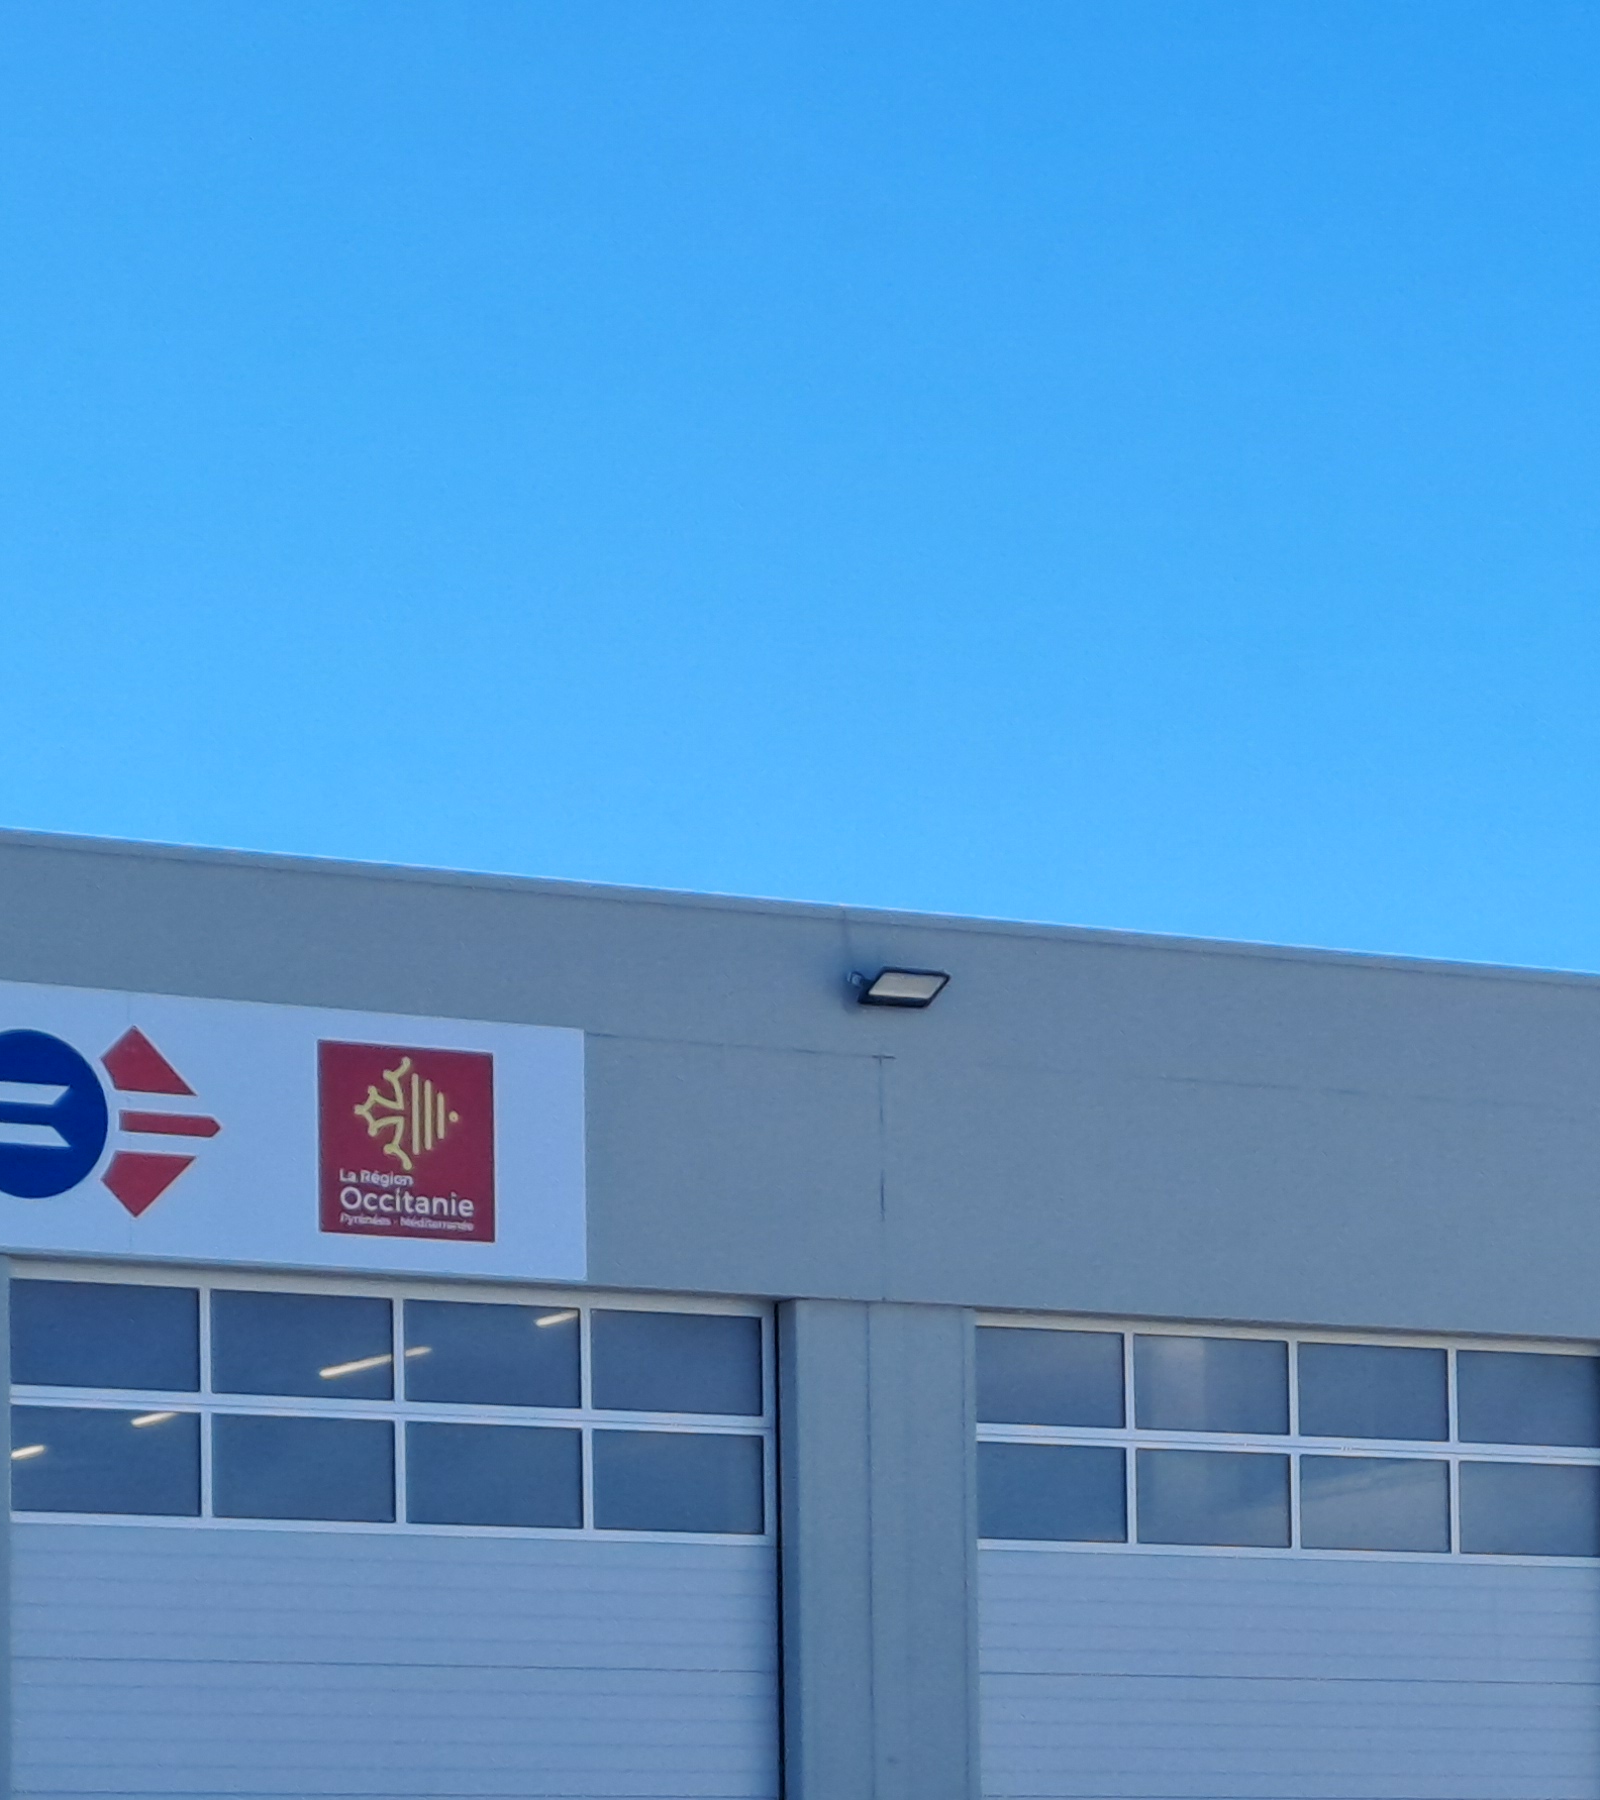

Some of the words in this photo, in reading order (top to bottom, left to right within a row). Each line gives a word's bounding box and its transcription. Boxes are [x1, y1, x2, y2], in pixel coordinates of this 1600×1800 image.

[339, 1168, 357, 1183] La
[360, 1170, 414, 1188] Région
[340, 1186, 475, 1218] Occitanie
